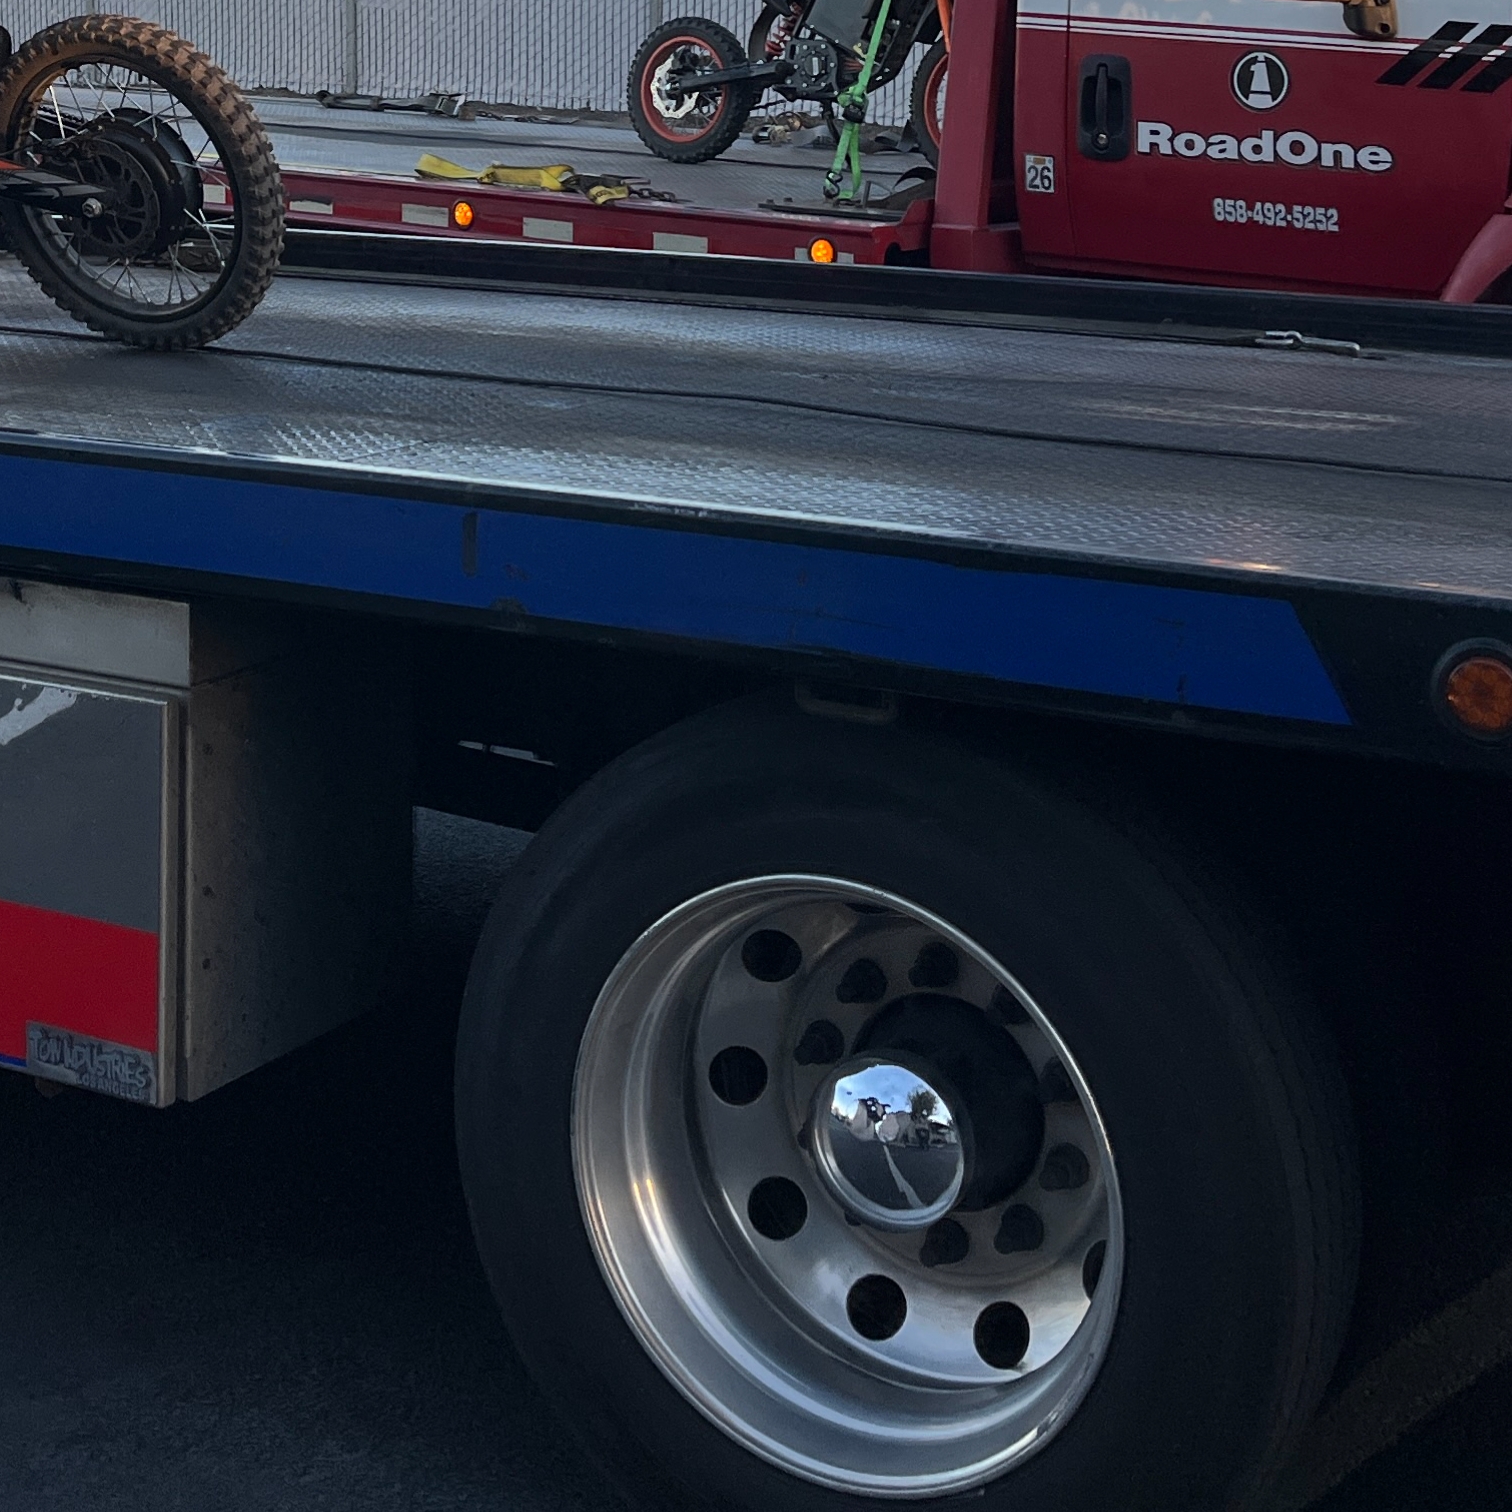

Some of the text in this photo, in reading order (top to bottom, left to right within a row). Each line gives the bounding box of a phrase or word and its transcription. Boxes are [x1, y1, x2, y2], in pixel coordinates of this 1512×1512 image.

[1136, 120, 1394, 172] RoadOne
[1027, 164, 1052, 191] 26
[1213, 197, 1339, 232] 858-492-5252
